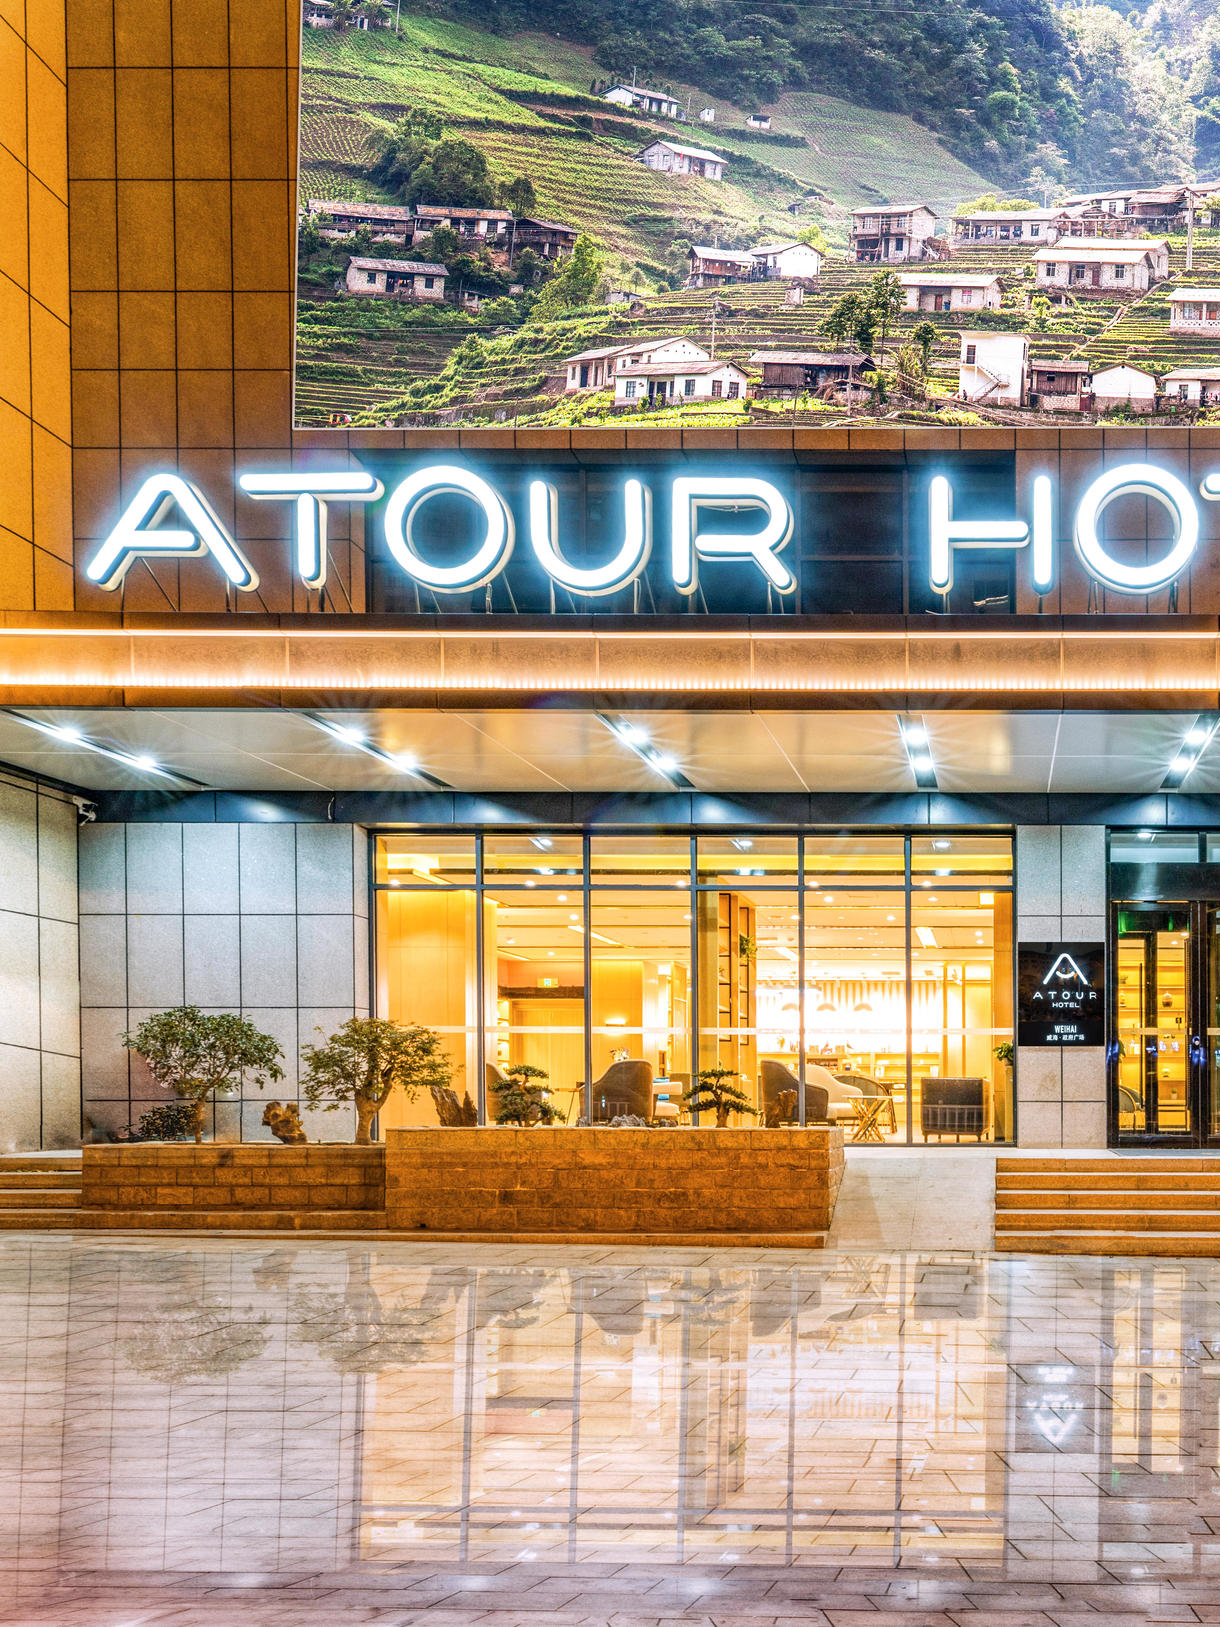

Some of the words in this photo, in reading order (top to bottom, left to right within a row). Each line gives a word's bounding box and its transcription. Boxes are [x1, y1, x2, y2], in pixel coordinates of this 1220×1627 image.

[87, 465, 798, 595] ATOUR
[1033, 991, 1097, 1000] ATOUR
[1054, 1024, 1077, 1033] WEIHAI
